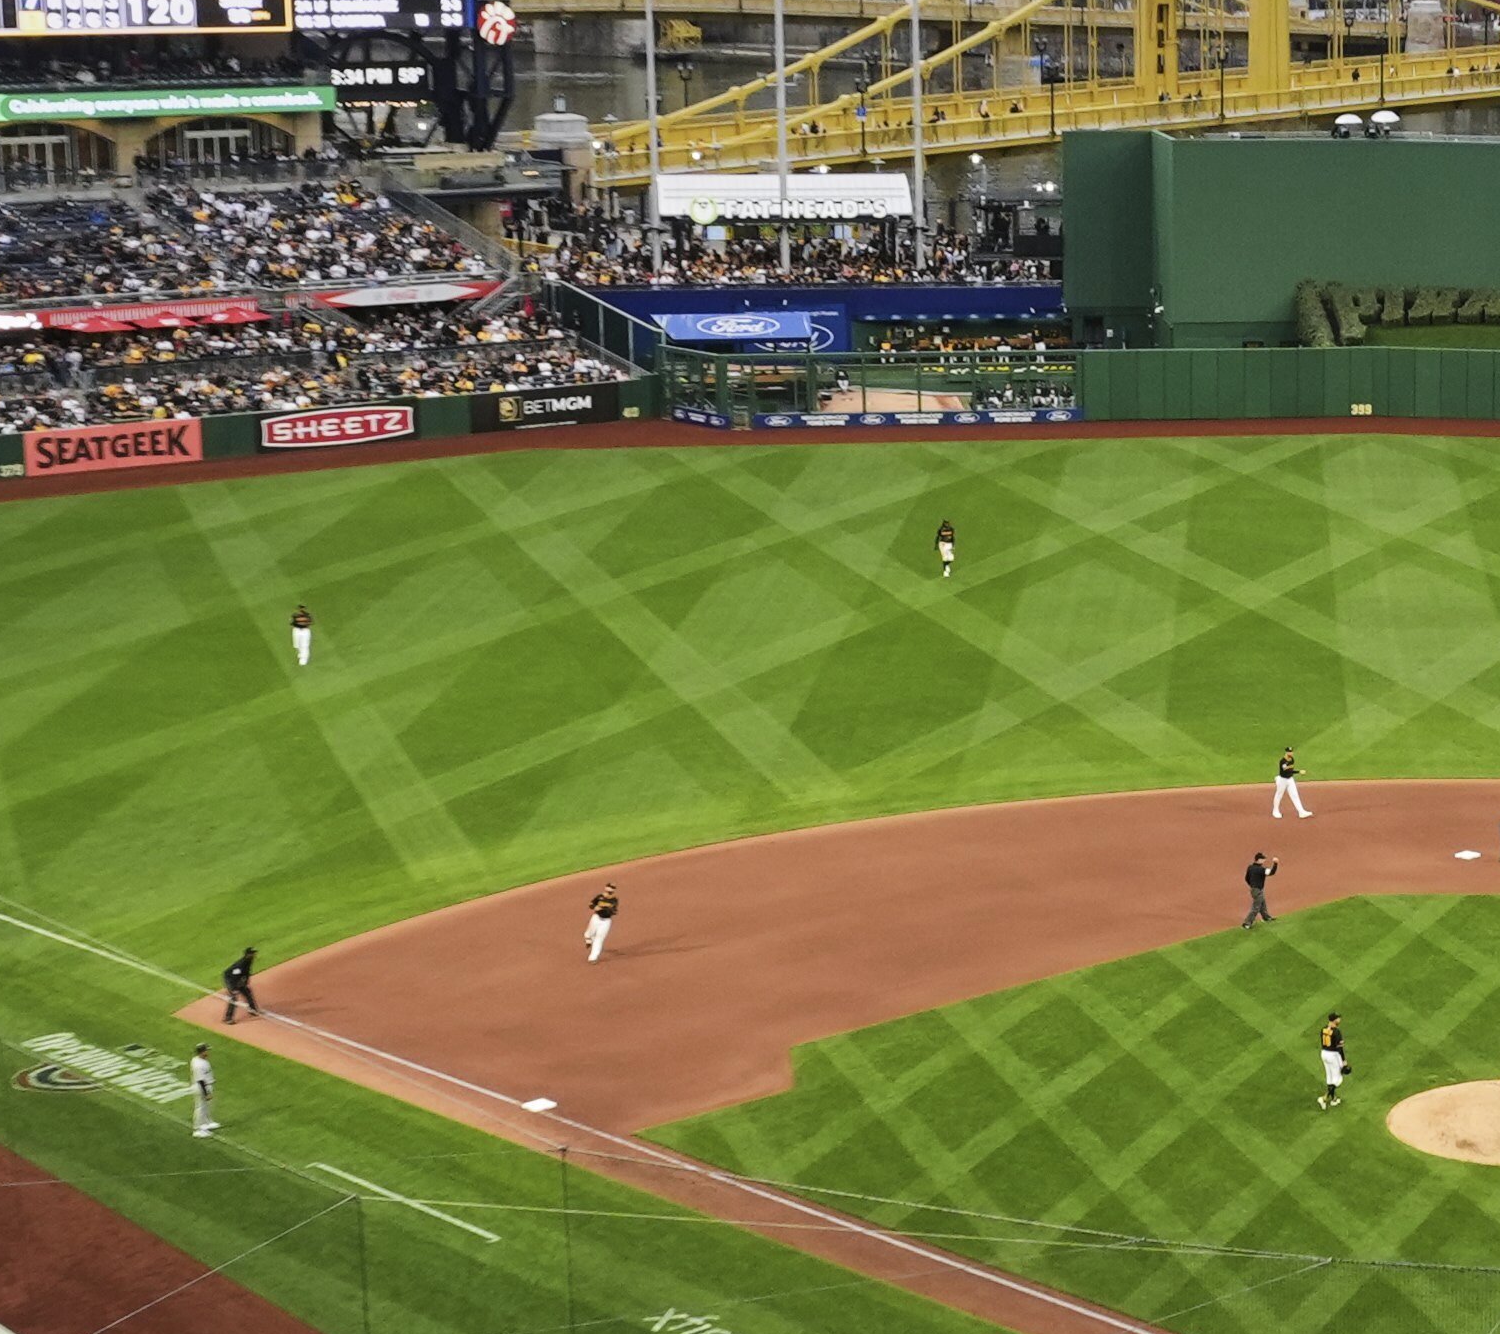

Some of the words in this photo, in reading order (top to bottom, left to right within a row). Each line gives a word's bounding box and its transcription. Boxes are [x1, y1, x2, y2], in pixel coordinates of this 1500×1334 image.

[366, 68, 393, 85] PM
[9, 98, 96, 116] Celebrating
[95, 99, 159, 115] everyone
[723, 198, 772, 219] FAT
[781, 196, 888, 220] HEAD'S
[713, 318, 763, 334] Ford
[523, 395, 593, 417] BETMGM
[1351, 403, 1373, 416] 399
[272, 410, 402, 443] SHEETZ
[36, 424, 190, 469] SEATGEEK
